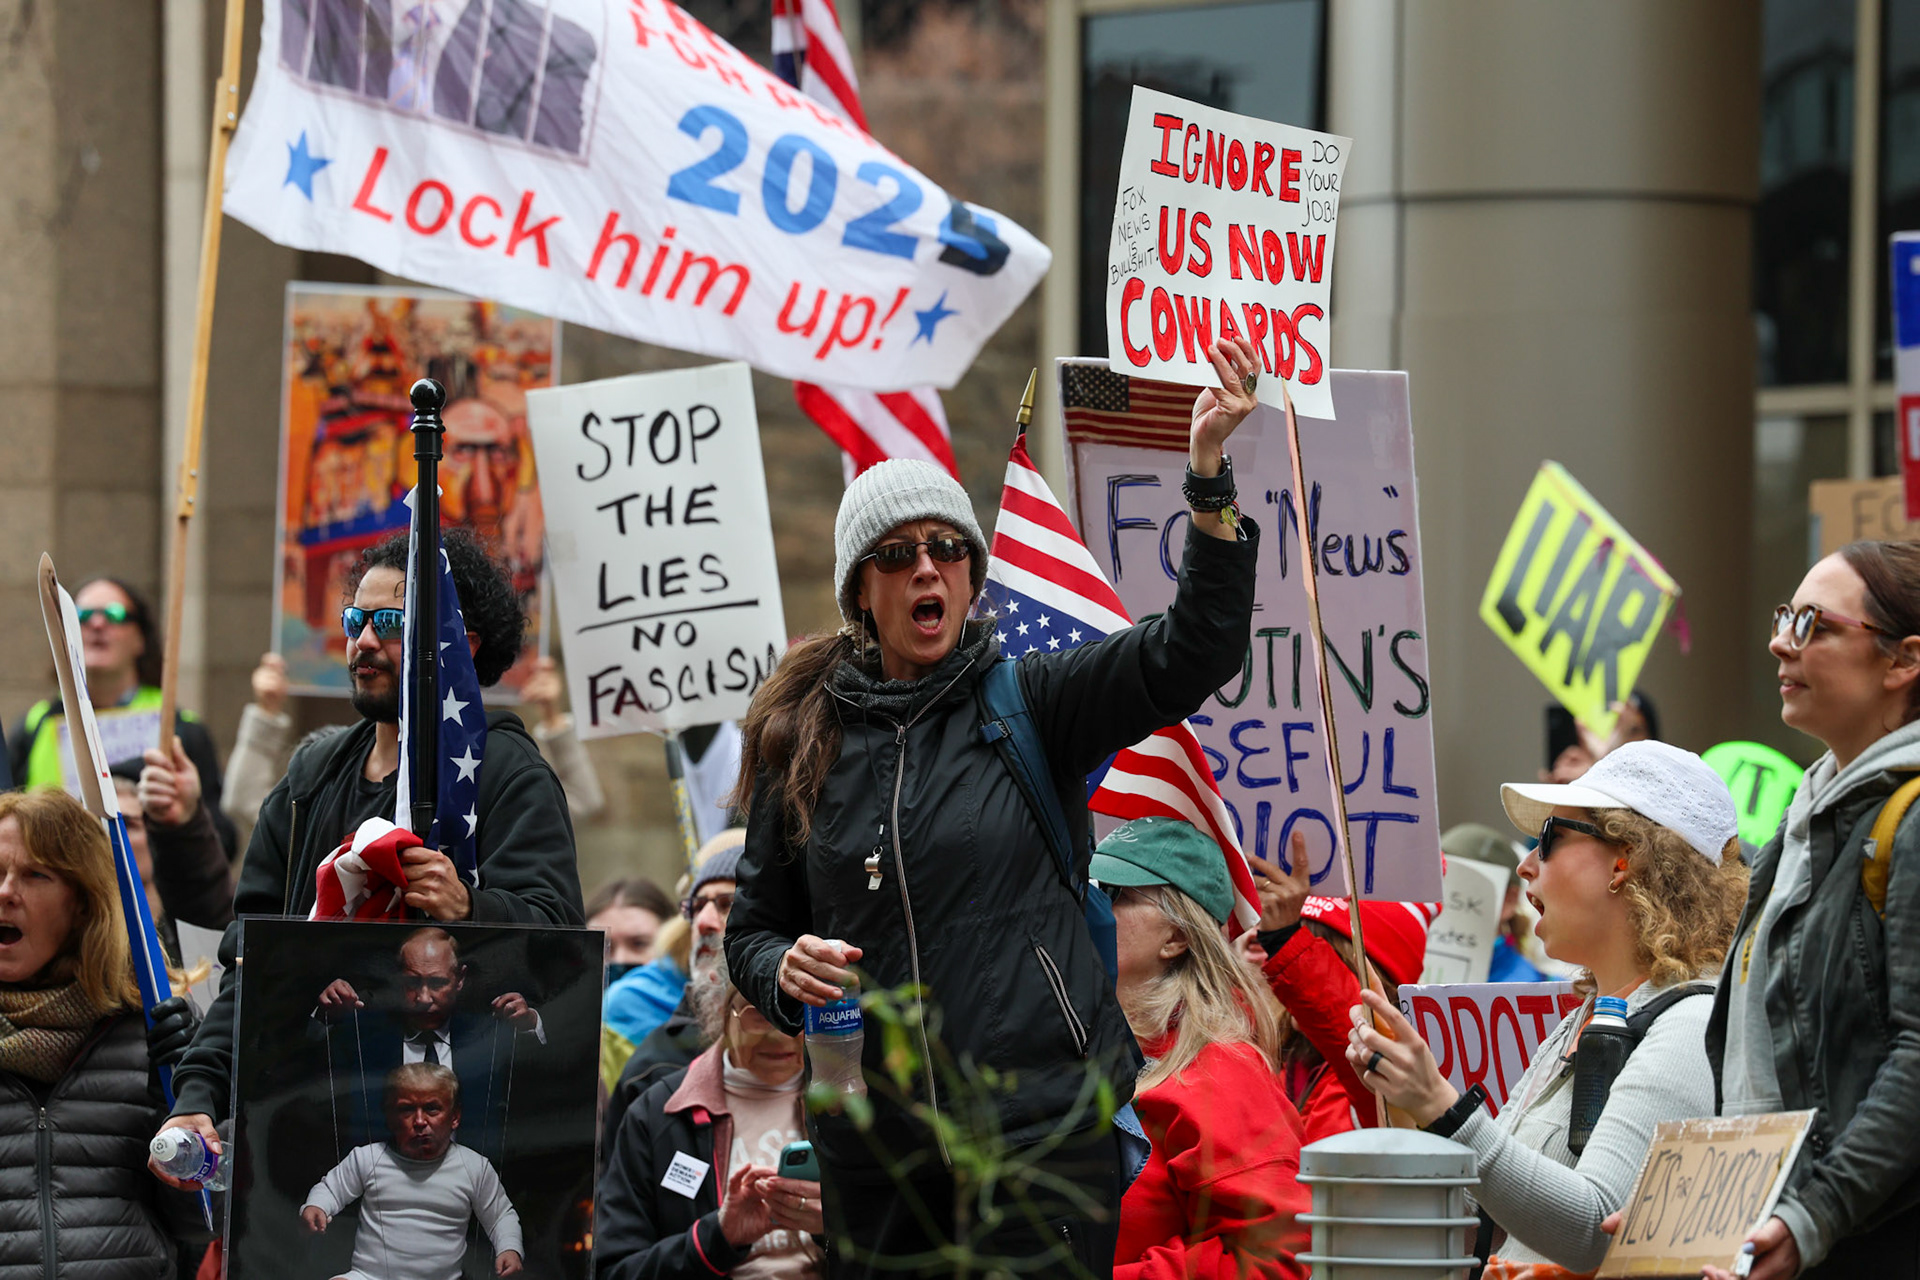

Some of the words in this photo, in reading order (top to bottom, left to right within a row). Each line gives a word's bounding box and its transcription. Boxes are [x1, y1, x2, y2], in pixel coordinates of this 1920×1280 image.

[1151, 113, 1302, 203] IGNORE
[1312, 140, 1340, 164] DO
[1122, 185, 1147, 216] FOX
[1304, 168, 1339, 193] YOUR
[1118, 213, 1150, 246] NEWS
[1301, 197, 1336, 227] JOB!
[352, 147, 562, 268] Lock
[585, 210, 751, 318] him
[776, 281, 911, 359] up!
[1110, 238, 1160, 285] BULLSHIT!
[1128, 241, 1138, 257] IS
[1158, 206, 1212, 278] US
[1228, 224, 1326, 285] NOW
[1120, 277, 1324, 385] COWARDS
[577, 405, 721, 481] STOP
[597, 484, 721, 535] THE
[598, 554, 729, 611] LIES
[1496, 499, 1663, 713] LIAR
[632, 620, 698, 651] NO
[588, 643, 779, 727] FASCISM
[1187, 714, 1420, 799] SEFUL
[818, 1007, 862, 1024] AQUAFINA
[1411, 994, 1587, 1120] PROT
